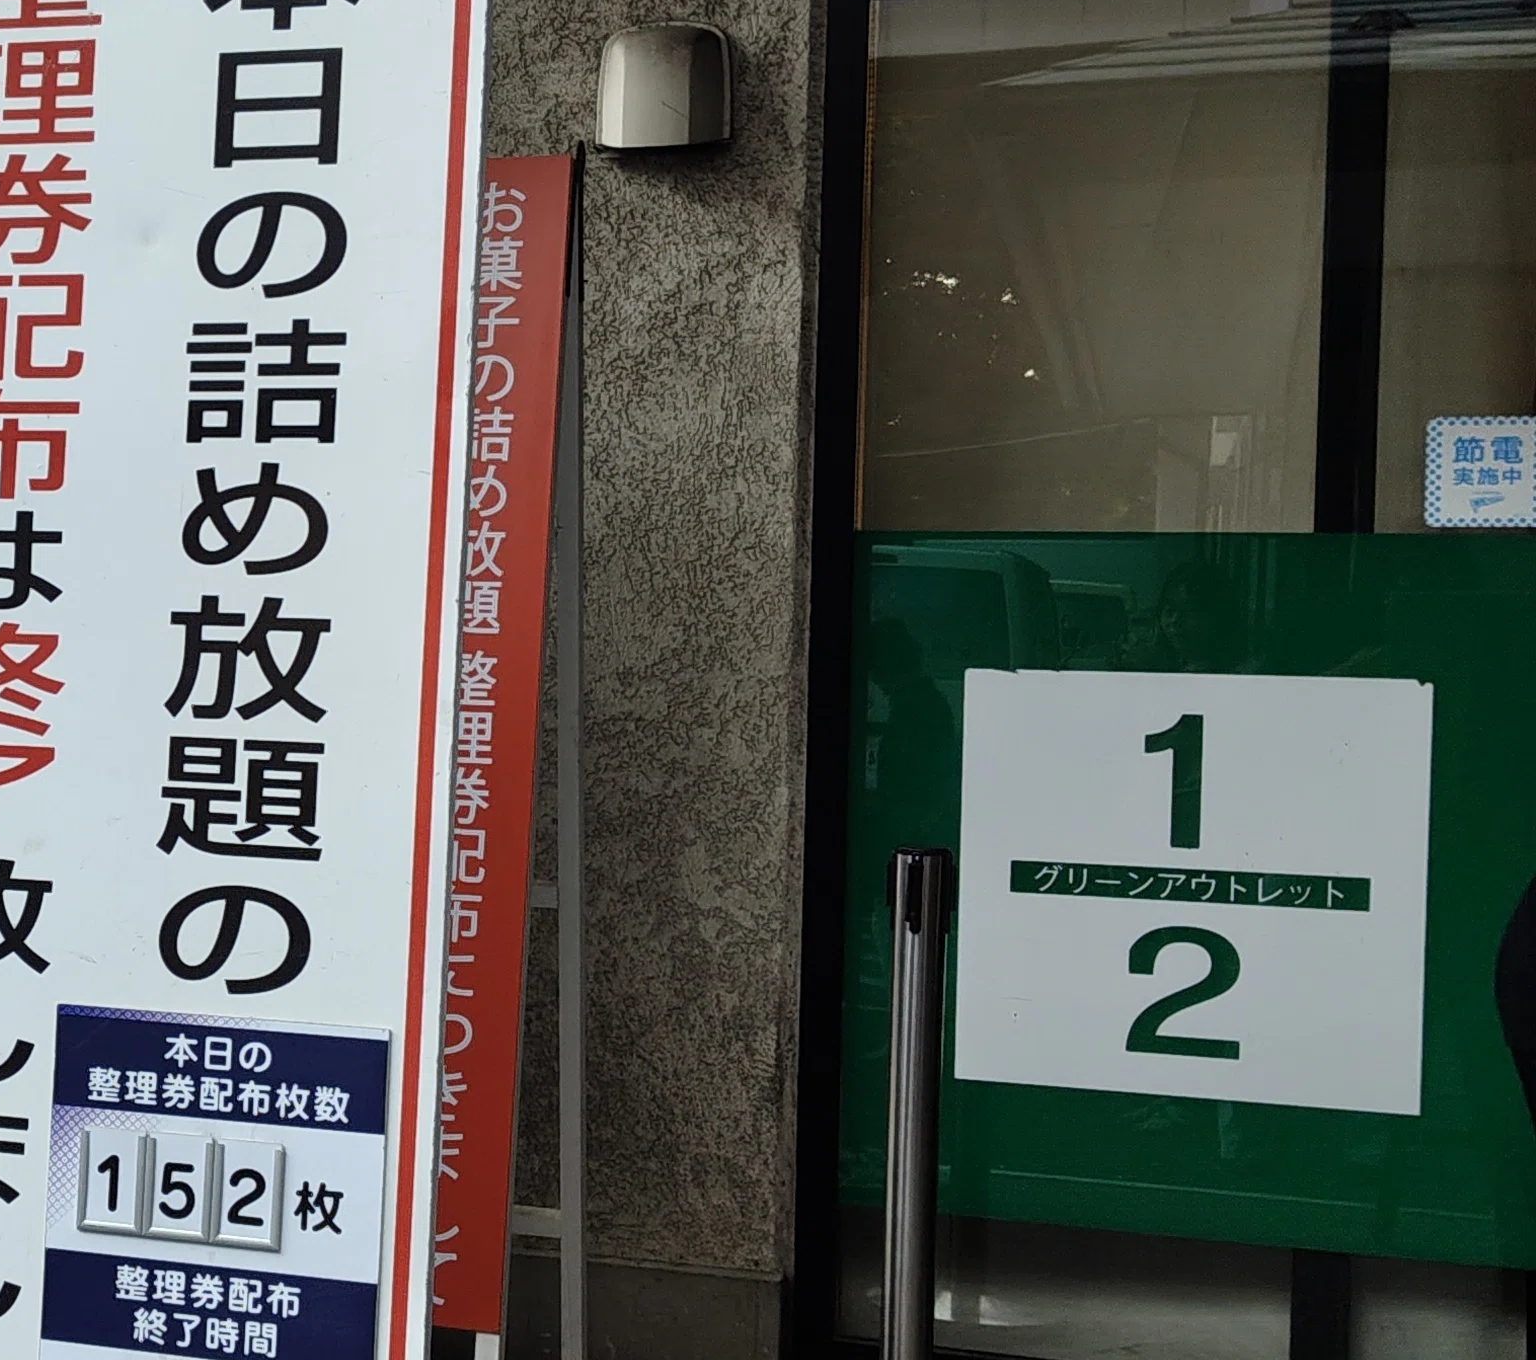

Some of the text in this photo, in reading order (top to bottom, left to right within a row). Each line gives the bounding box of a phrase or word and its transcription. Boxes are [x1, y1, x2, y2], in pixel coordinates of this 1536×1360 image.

[1452, 436, 1523, 464] 節電
[1452, 467, 1523, 486] 実施中
[1144, 713, 1204, 850] 1
[1034, 865, 1345, 905] グリーンアウトレット
[1125, 925, 1241, 1060] 2
[164, 1033, 272, 1072] 本日の
[87, 1066, 350, 1124] 整理券配布枚数
[115, 1264, 301, 1318] 整理券配布
[133, 1309, 278, 1358] 終了時間
